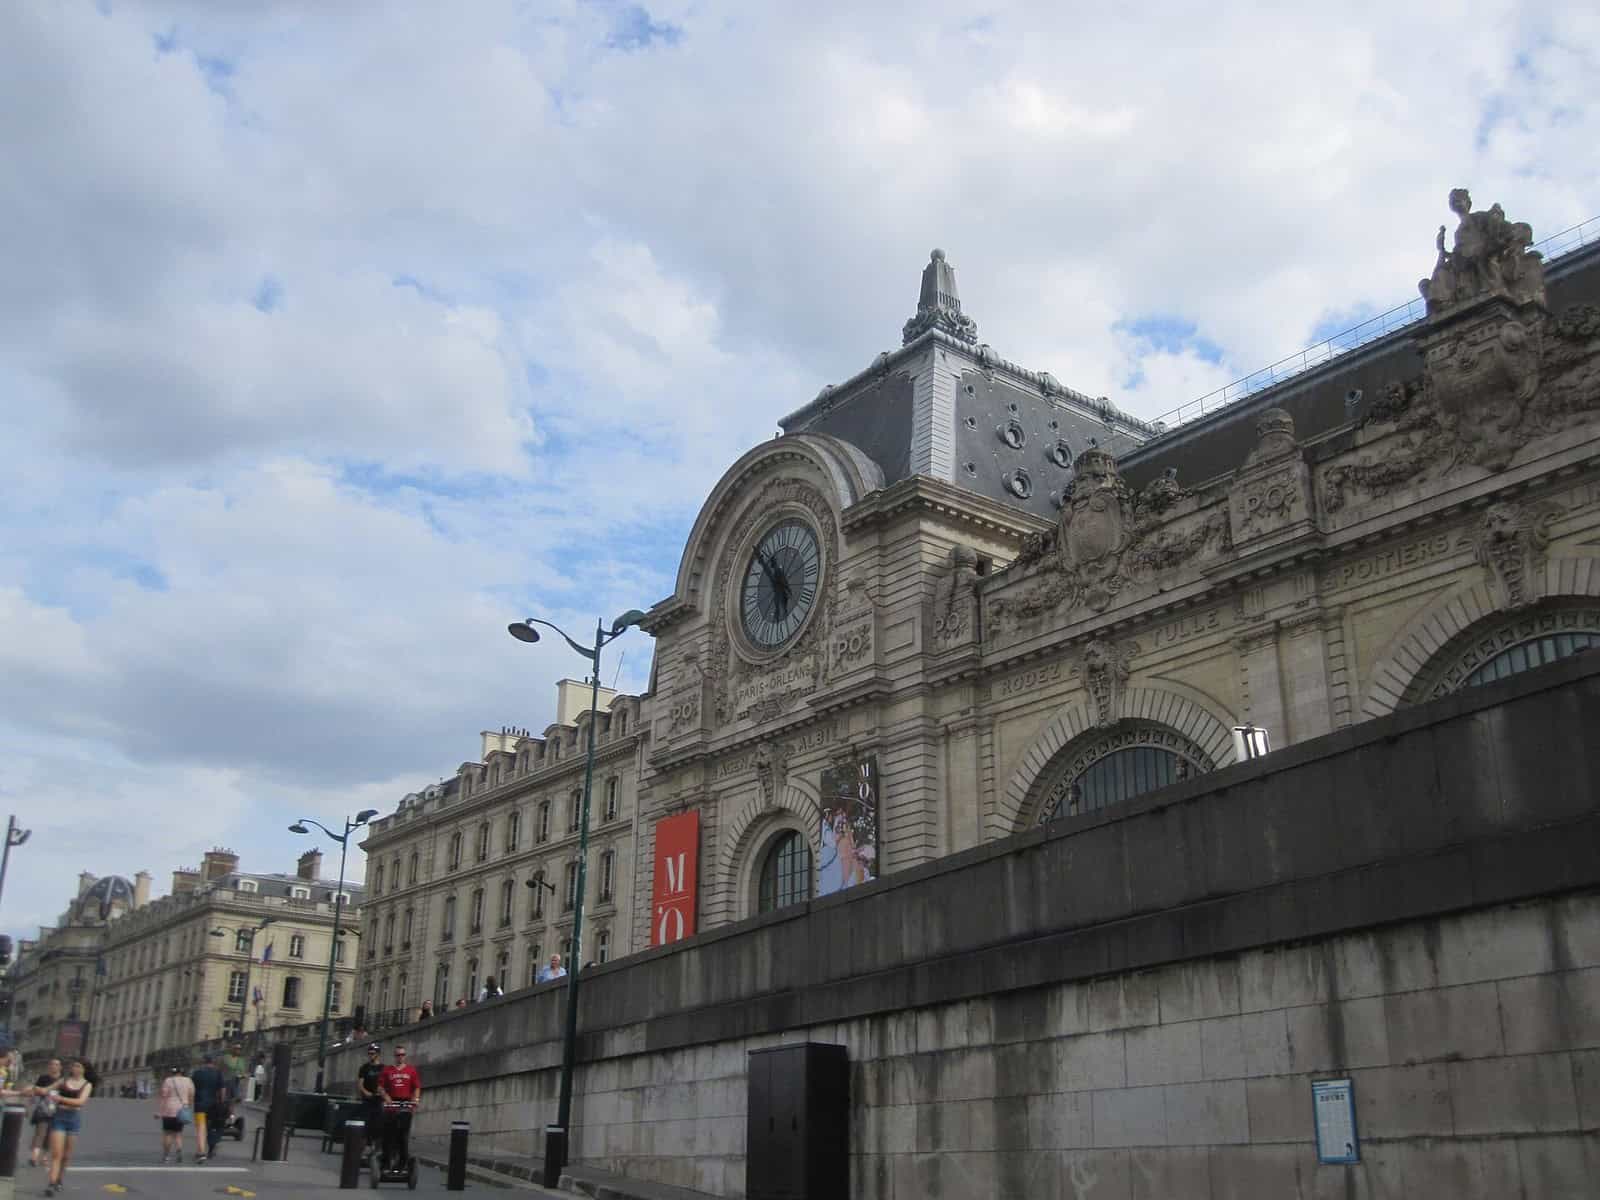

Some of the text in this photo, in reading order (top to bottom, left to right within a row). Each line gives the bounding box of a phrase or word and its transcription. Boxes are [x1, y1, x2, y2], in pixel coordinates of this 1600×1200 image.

[1343, 534, 1451, 586] POITIERS
[1152, 608, 1221, 647] TULLE
[835, 634, 863, 659] PO
[1001, 663, 1062, 698] RODEZ
[671, 701, 693, 722] PO
[664, 851, 688, 896] M
